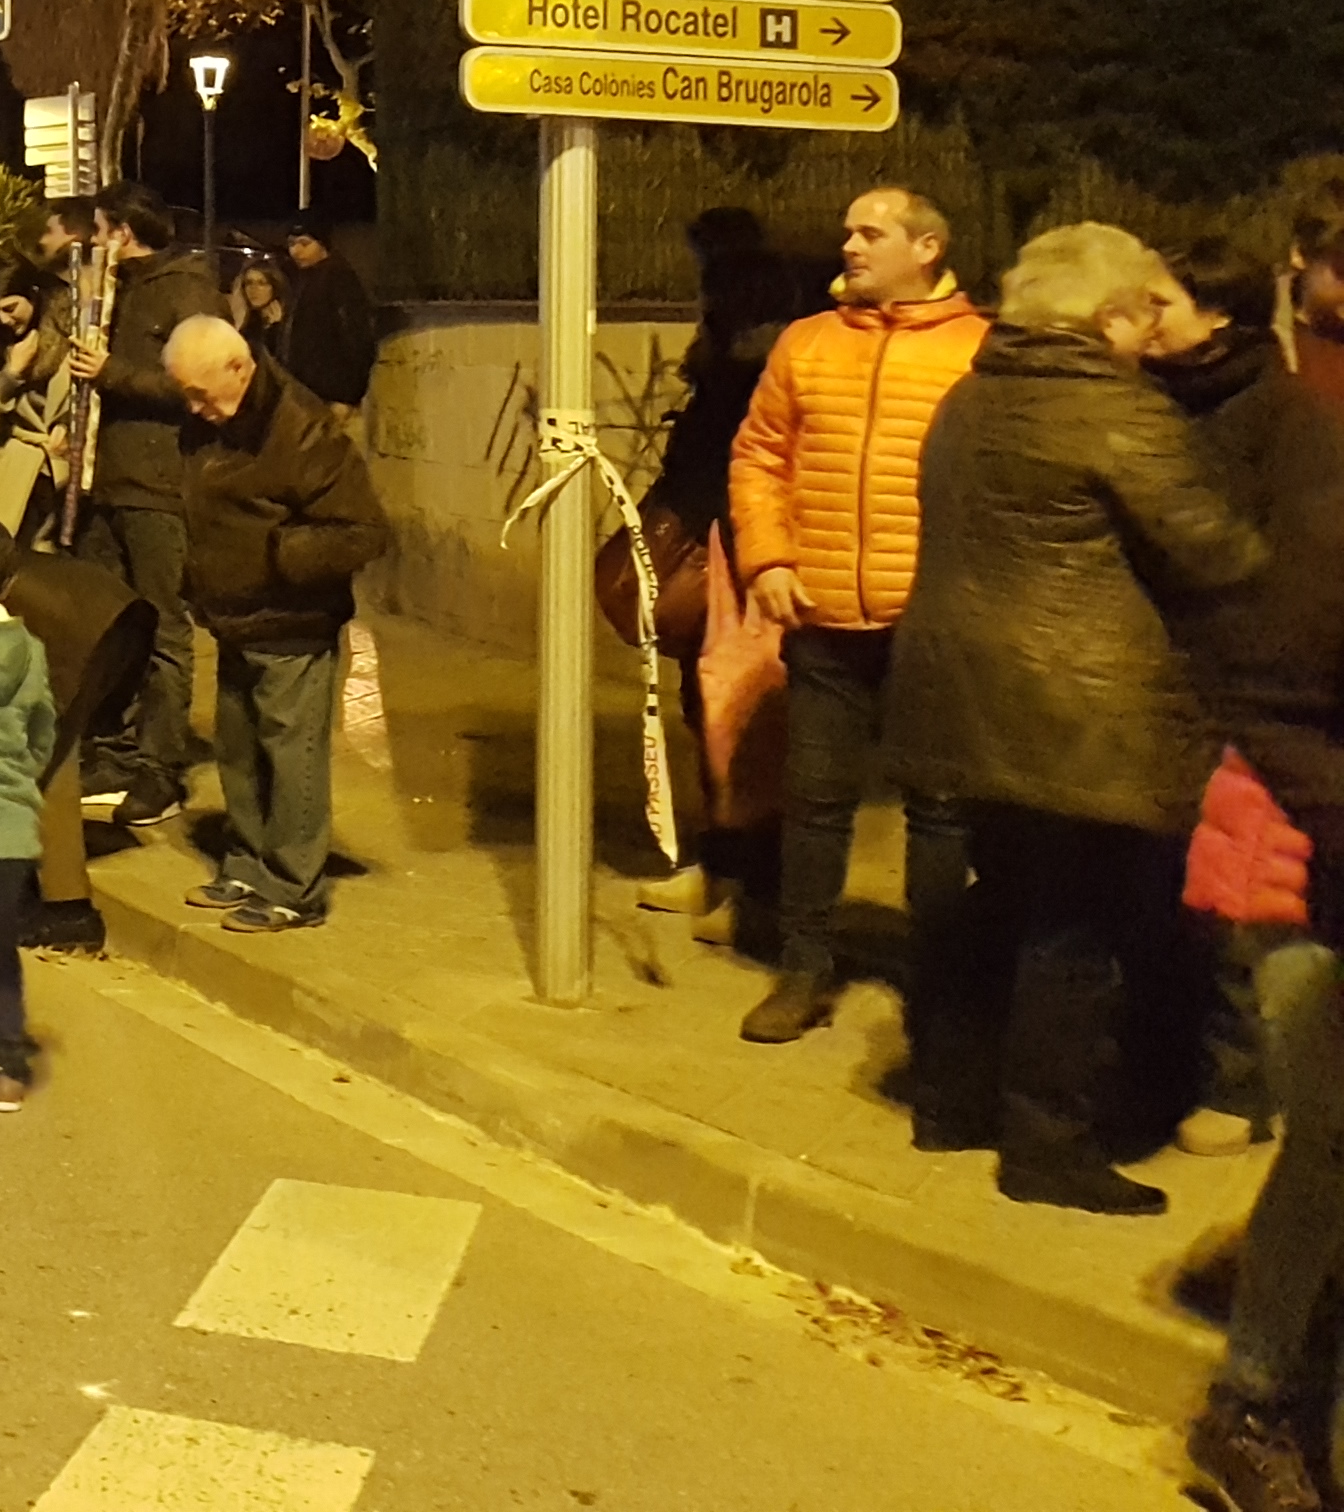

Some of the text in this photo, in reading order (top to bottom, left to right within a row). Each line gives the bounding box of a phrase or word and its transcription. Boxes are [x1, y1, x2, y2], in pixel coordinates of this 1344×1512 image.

[621, 0, 739, 40] Rocatel
[529, 69, 574, 94] Casa
[662, 66, 709, 102] Can
[717, 69, 833, 114] Brugarola
